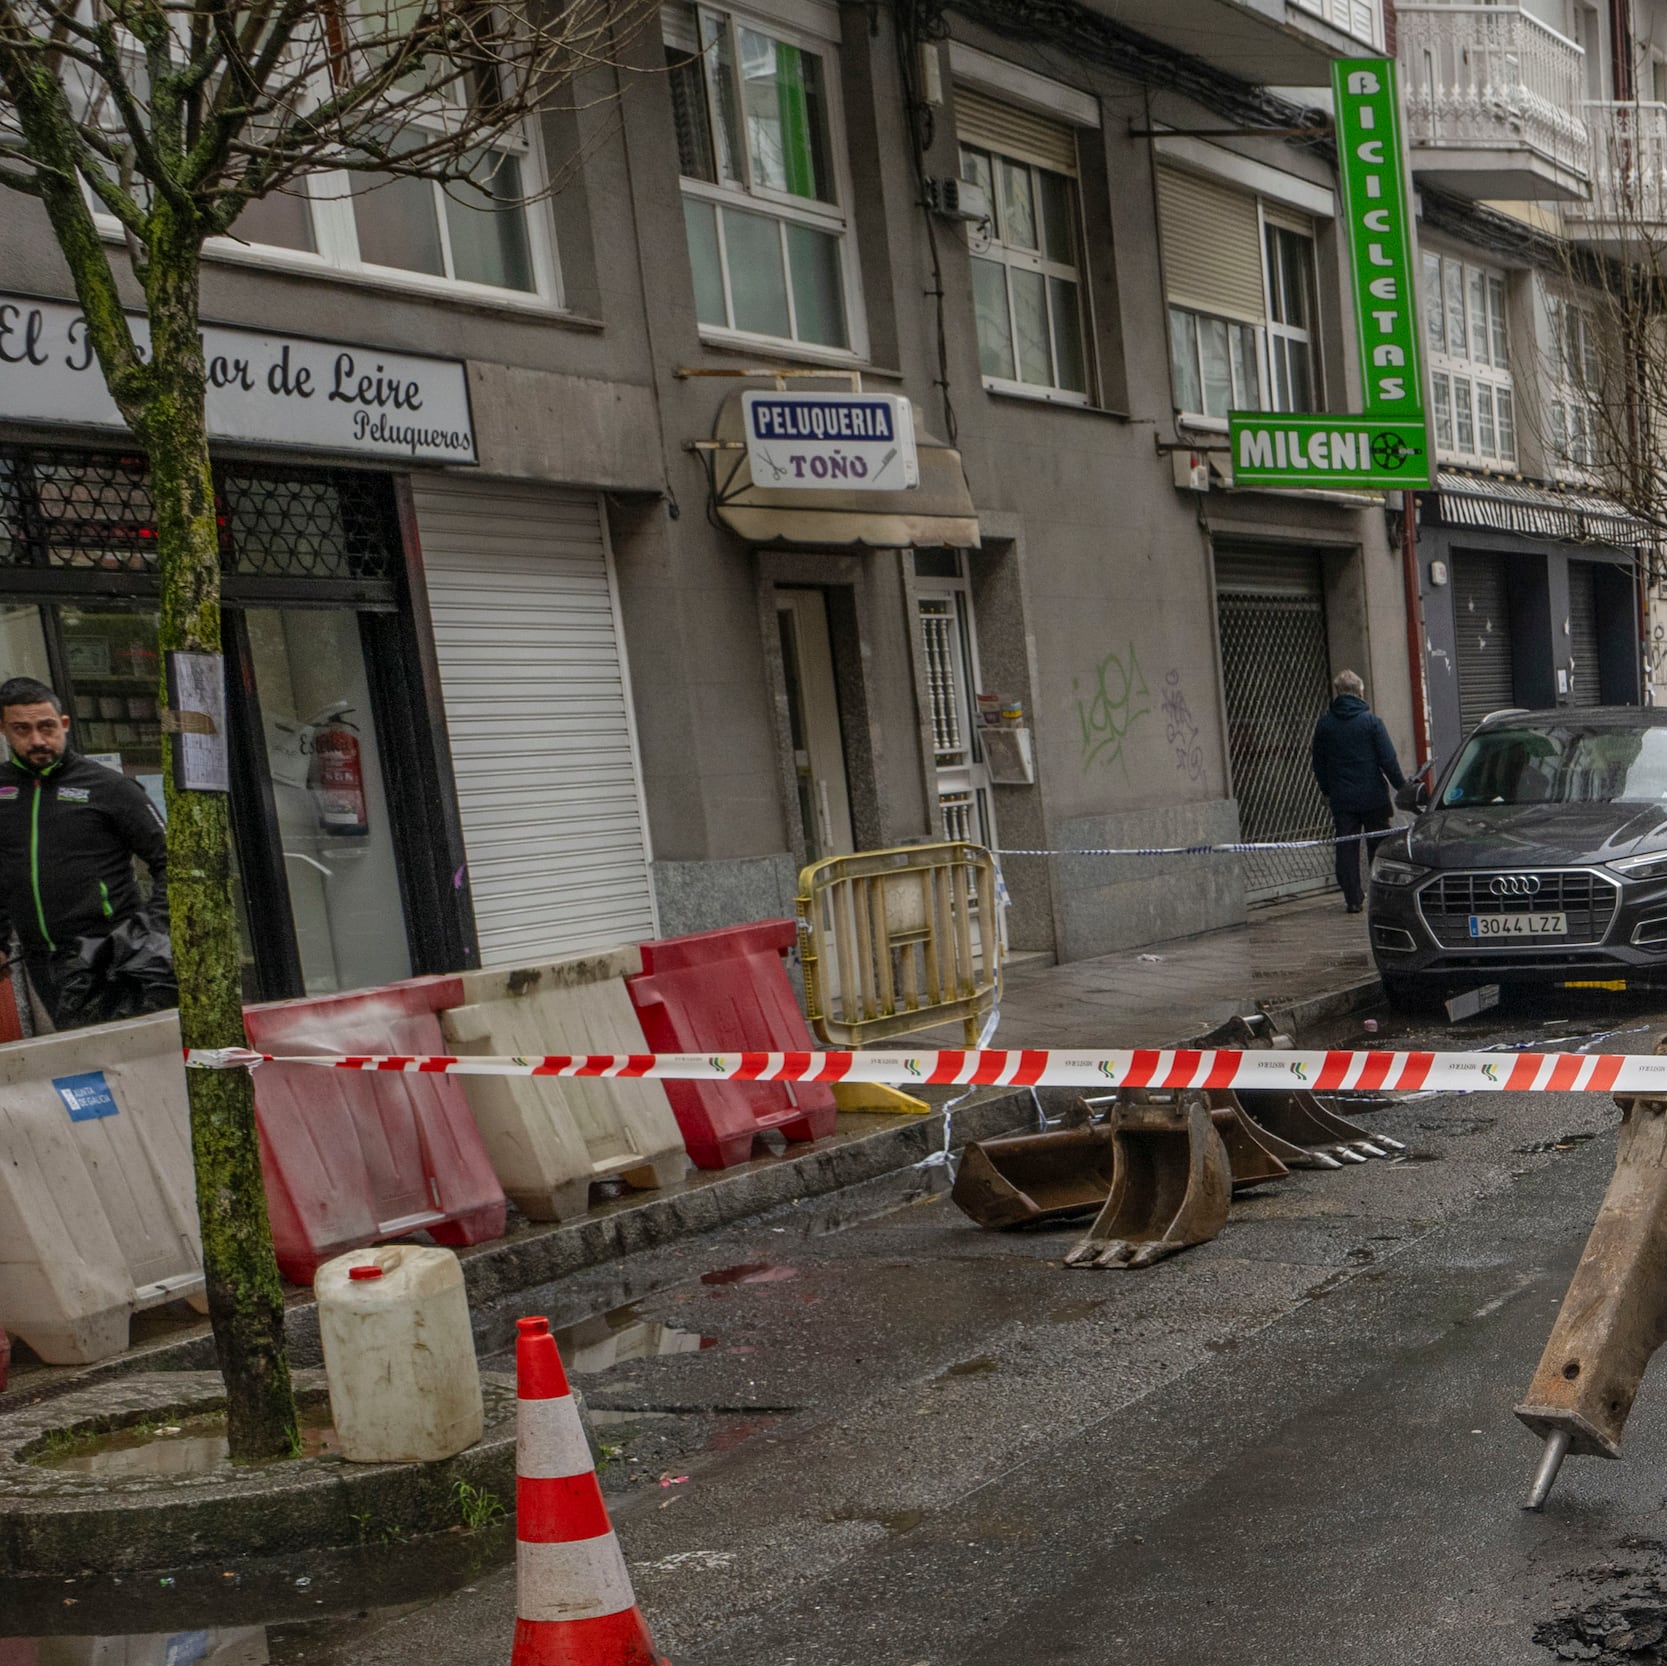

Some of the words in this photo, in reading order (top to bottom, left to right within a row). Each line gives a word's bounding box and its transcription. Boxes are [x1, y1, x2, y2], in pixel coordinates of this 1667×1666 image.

[1346, 70, 1407, 401] BICICLETAS
[0, 304, 49, 366] El
[267, 345, 316, 398] de
[327, 351, 424, 412] Leire
[352, 408, 472, 456] Peluqueros
[756, 405, 890, 440] PELUQUERIA
[789, 448, 869, 479] TOÑO
[1480, 918, 1523, 935] 3044
[1528, 916, 1562, 934] LZZ
